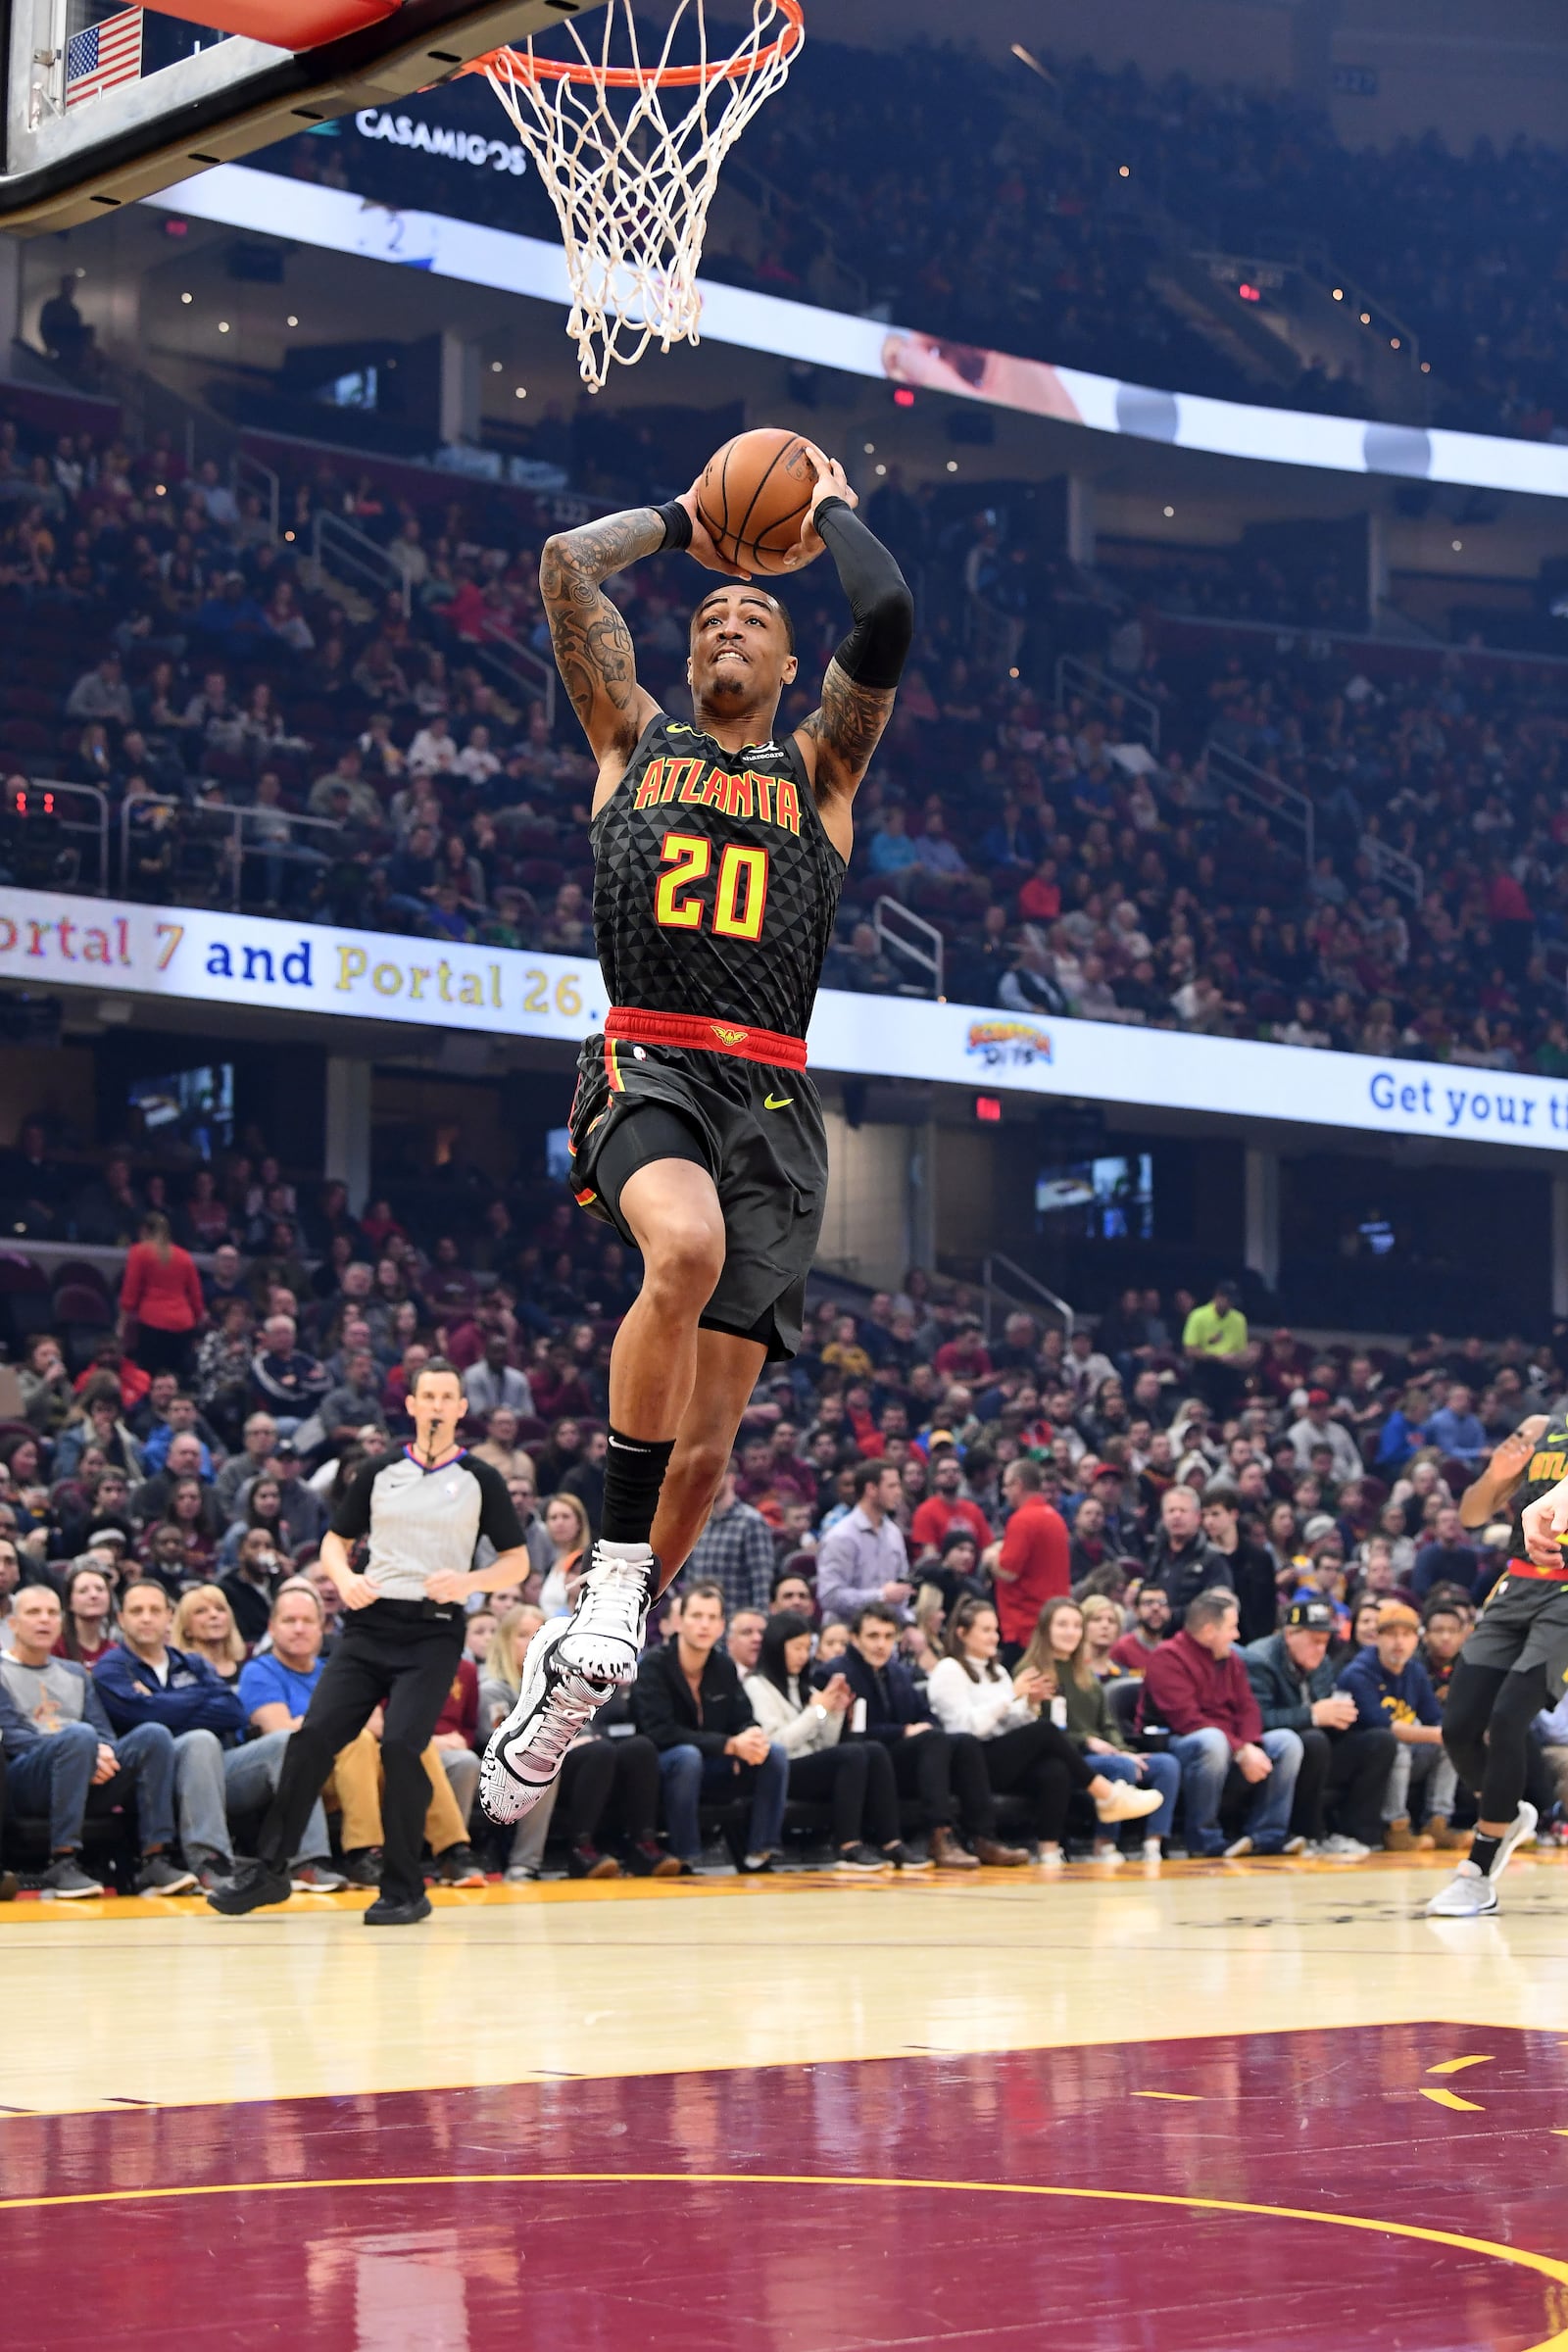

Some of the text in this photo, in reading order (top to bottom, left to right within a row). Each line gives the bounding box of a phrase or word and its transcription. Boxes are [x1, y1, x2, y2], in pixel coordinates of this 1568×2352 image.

[356, 108, 527, 176] CASAMIGOS
[633, 757, 803, 837] ATLANTA
[654, 831, 769, 943] 20
[155, 923, 185, 972] 7
[206, 941, 314, 987] and
[335, 945, 503, 1008] Portal
[1369, 1073, 1432, 1114] Get
[1446, 1089, 1536, 1127] your
